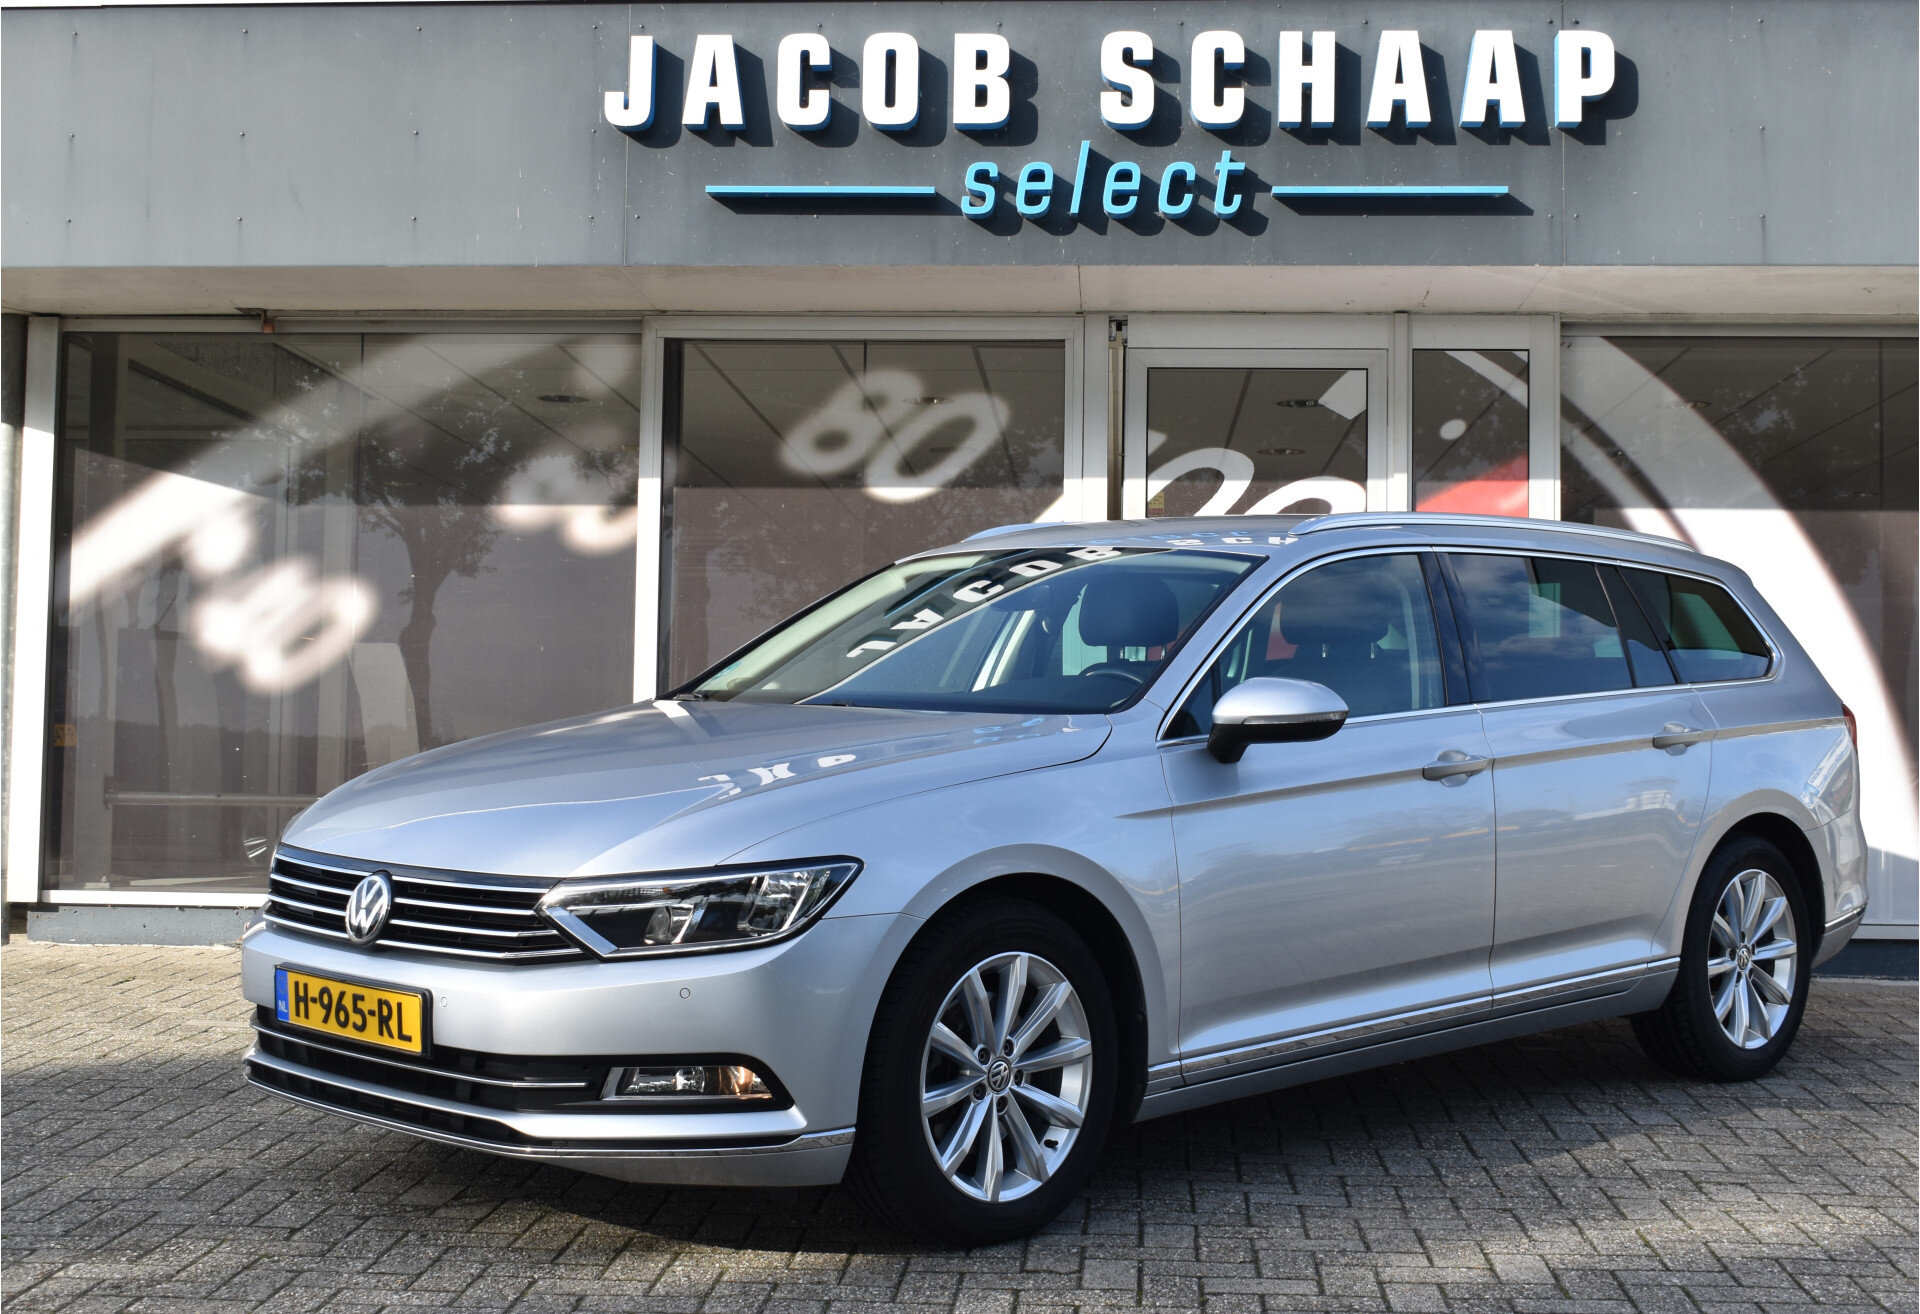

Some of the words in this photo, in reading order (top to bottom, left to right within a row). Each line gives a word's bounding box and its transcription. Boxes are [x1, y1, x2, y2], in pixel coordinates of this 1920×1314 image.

[604, 32, 1011, 131] JACOB
[1100, 29, 1615, 129] SCHAAP
[961, 140, 1246, 219] select
[278, 1000, 288, 1013] NL
[294, 980, 412, 1042] H-965-RL
